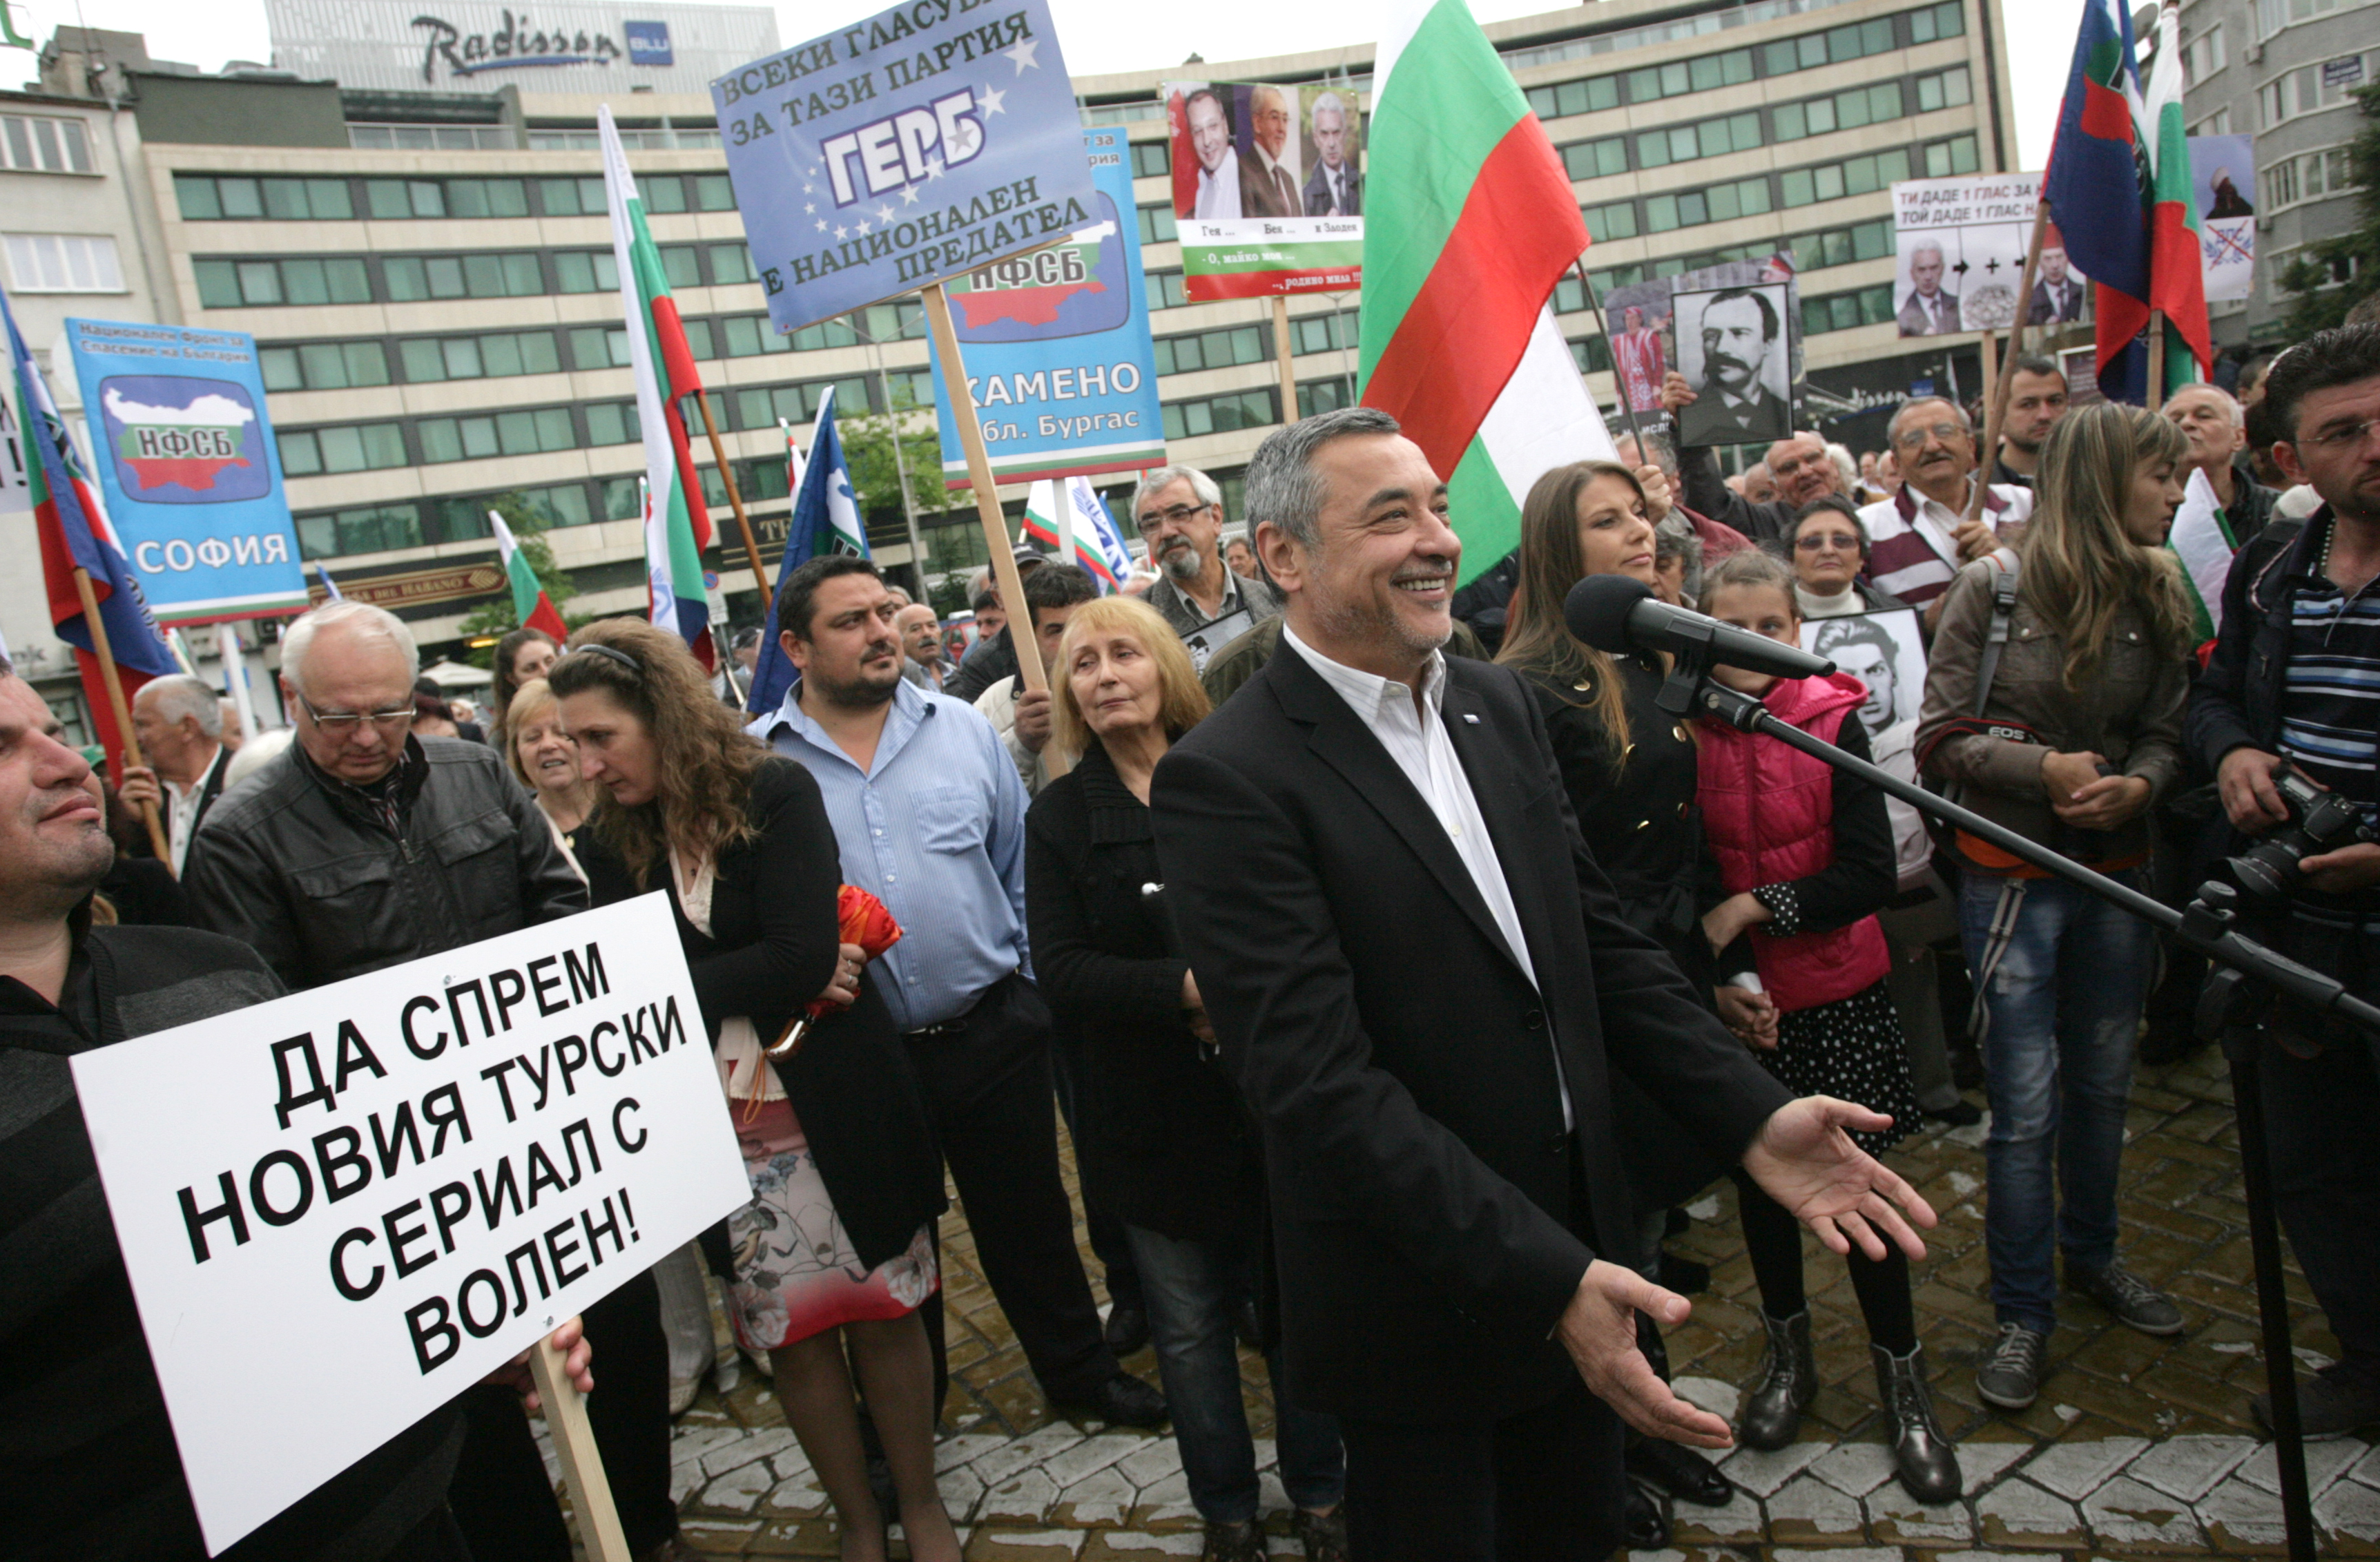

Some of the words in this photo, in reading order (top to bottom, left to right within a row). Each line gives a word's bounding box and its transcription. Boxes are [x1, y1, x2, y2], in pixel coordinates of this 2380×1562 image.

[412, 9, 621, 84] Radisson
[630, 37, 670, 51] BLU
[719, 39, 838, 108] ВСЕКИ
[843, 0, 993, 59] ГЛАСУ
[730, 113, 774, 146] ЗА
[781, 73, 878, 127] ТАЗИ
[884, 10, 1034, 92] ПАРТИЯ
[820, 85, 986, 209] ГЕРБ
[1095, 135, 1114, 146] за
[1900, 192, 1919, 206] ТИ
[1921, 189, 1960, 206] ДАДЕ
[1964, 189, 1970, 201] 1
[1974, 186, 2011, 200] ГЛАС
[2014, 184, 2032, 197] ЗА
[1902, 208, 1929, 224] ТОЙ
[1932, 206, 1971, 224] ДАДЕ
[1975, 208, 1982, 220] 1
[1986, 204, 2022, 219] ГЛАС
[762, 267, 784, 296] Е
[790, 176, 1041, 286] НАЦИОНАЛЕН
[893, 197, 1090, 284] ПРЕДАТЕЛ
[1201, 225, 1221, 237] Гея
[1264, 223, 1284, 235] Бея
[1324, 222, 1358, 233] Злодея
[1222, 250, 1259, 264] майко
[1261, 252, 1282, 261] моя
[1285, 277, 1324, 291] родино
[1326, 273, 1351, 285] мила
[78, 322, 177, 342] Национален
[135, 425, 235, 459] НФСБ
[982, 419, 1028, 443] бл.
[1038, 410, 1139, 440] Бургас
[135, 533, 289, 575] СОФИЯ
[1989, 726, 2025, 740] EOS
[270, 1019, 387, 1130] ДА
[400, 941, 610, 1061] СПРЕМ
[177, 1081, 474, 1264] НОВИЯ
[480, 995, 688, 1123] ТУРСКИ
[329, 1117, 602, 1302] СЕРИАЛ
[612, 1097, 648, 1154] С
[404, 1187, 641, 1376] ВОЛЕН!
